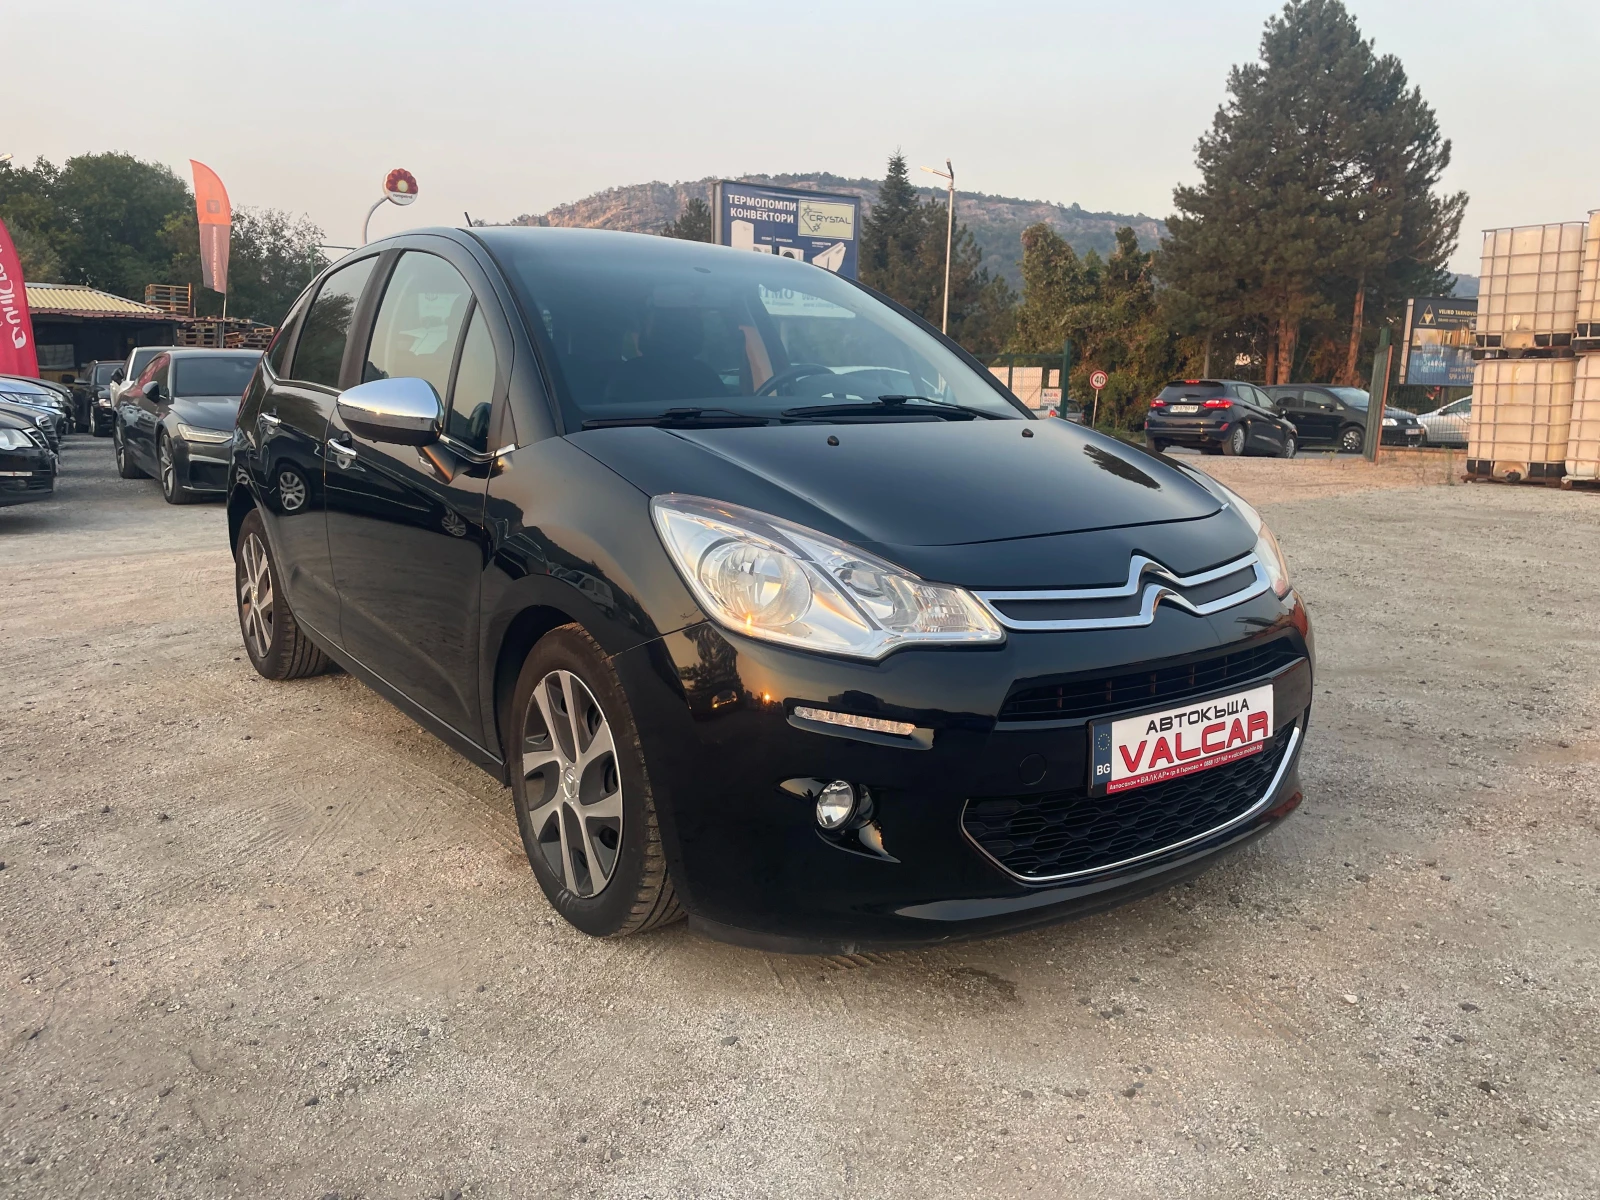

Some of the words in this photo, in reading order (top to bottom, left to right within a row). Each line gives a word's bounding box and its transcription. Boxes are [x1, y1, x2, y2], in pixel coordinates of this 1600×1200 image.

[728, 194, 796, 211] ТЕРМОПОМПИ
[730, 207, 794, 224] КОНВЕКТОРИ
[809, 214, 852, 225] CRYSTAL
[1094, 376, 1104, 385] 40
[1118, 710, 1269, 773] VALCAR
[1096, 763, 1111, 776] BG
[1140, 771, 1167, 784] ВАЛКАР
